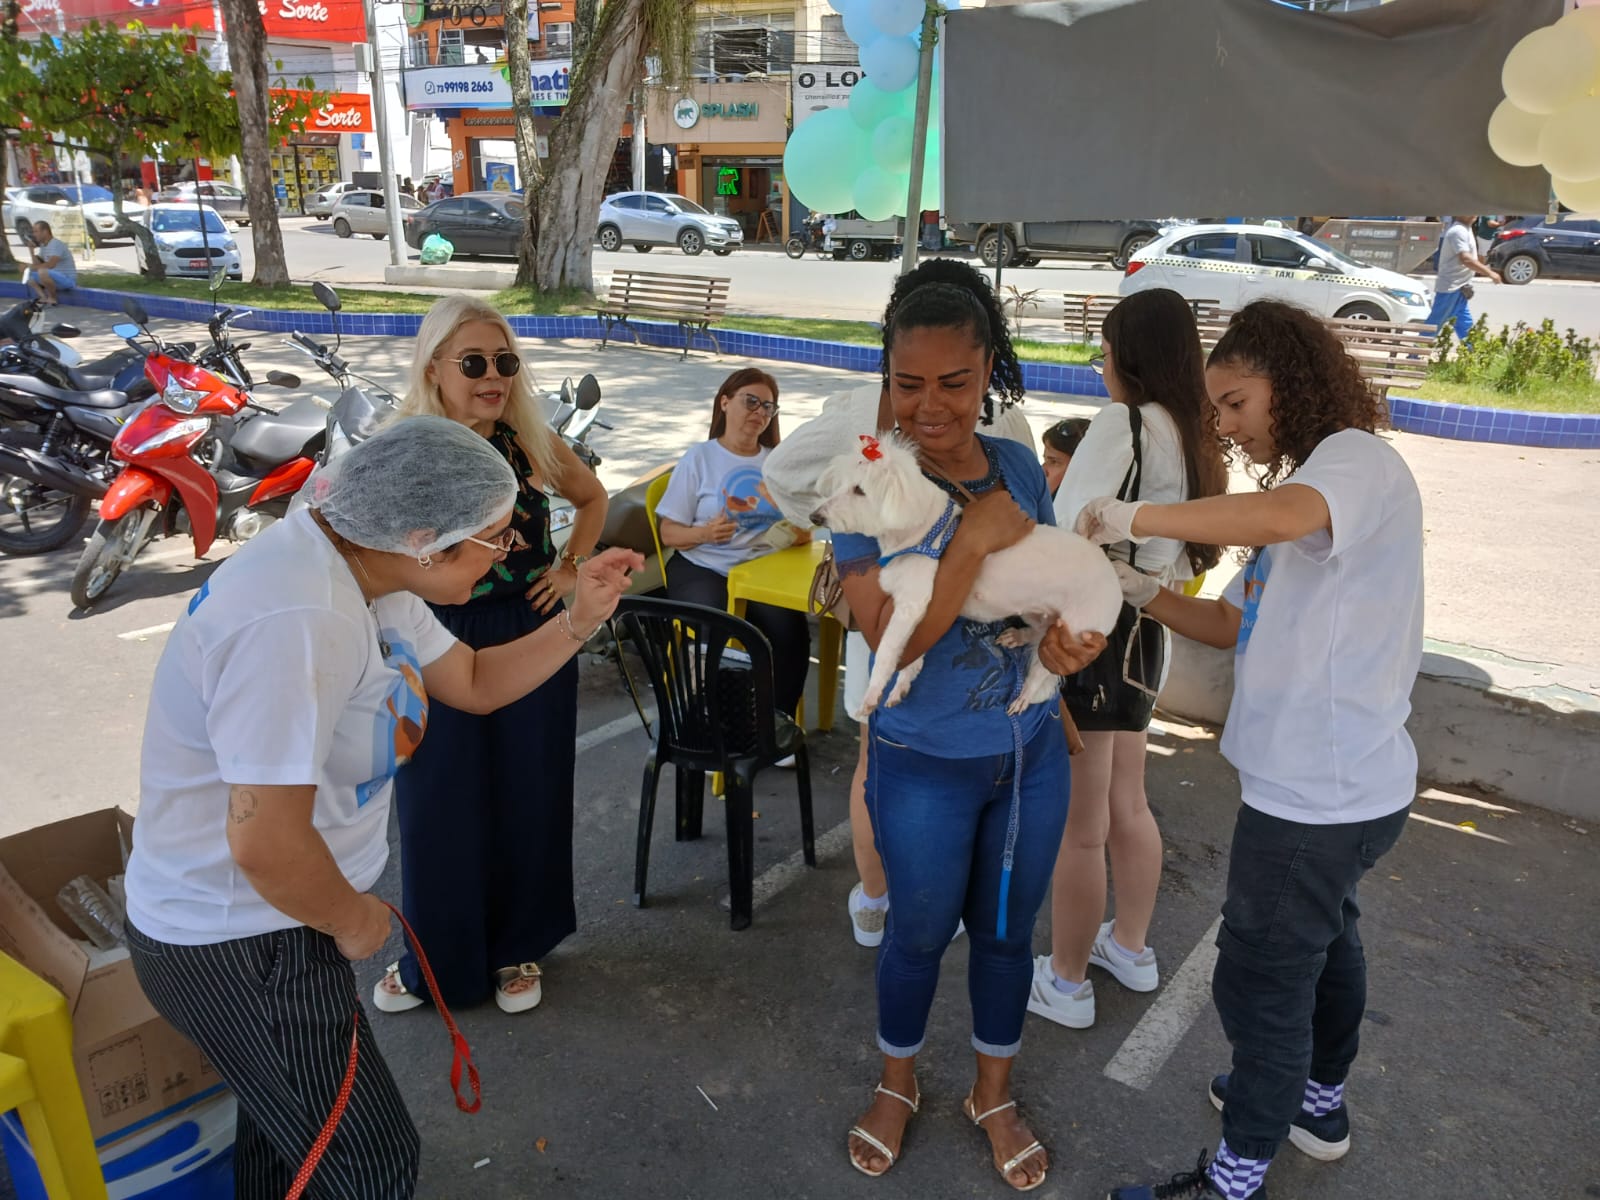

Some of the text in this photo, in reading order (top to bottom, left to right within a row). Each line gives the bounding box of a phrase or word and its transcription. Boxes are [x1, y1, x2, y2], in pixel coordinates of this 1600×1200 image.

[279, 0, 329, 22] Sorte
[444, 81, 470, 93] 99198
[471, 80, 494, 92] 2663
[798, 72, 816, 89] O
[315, 103, 363, 128] Sorte
[1274, 270, 1295, 279] TAXI
